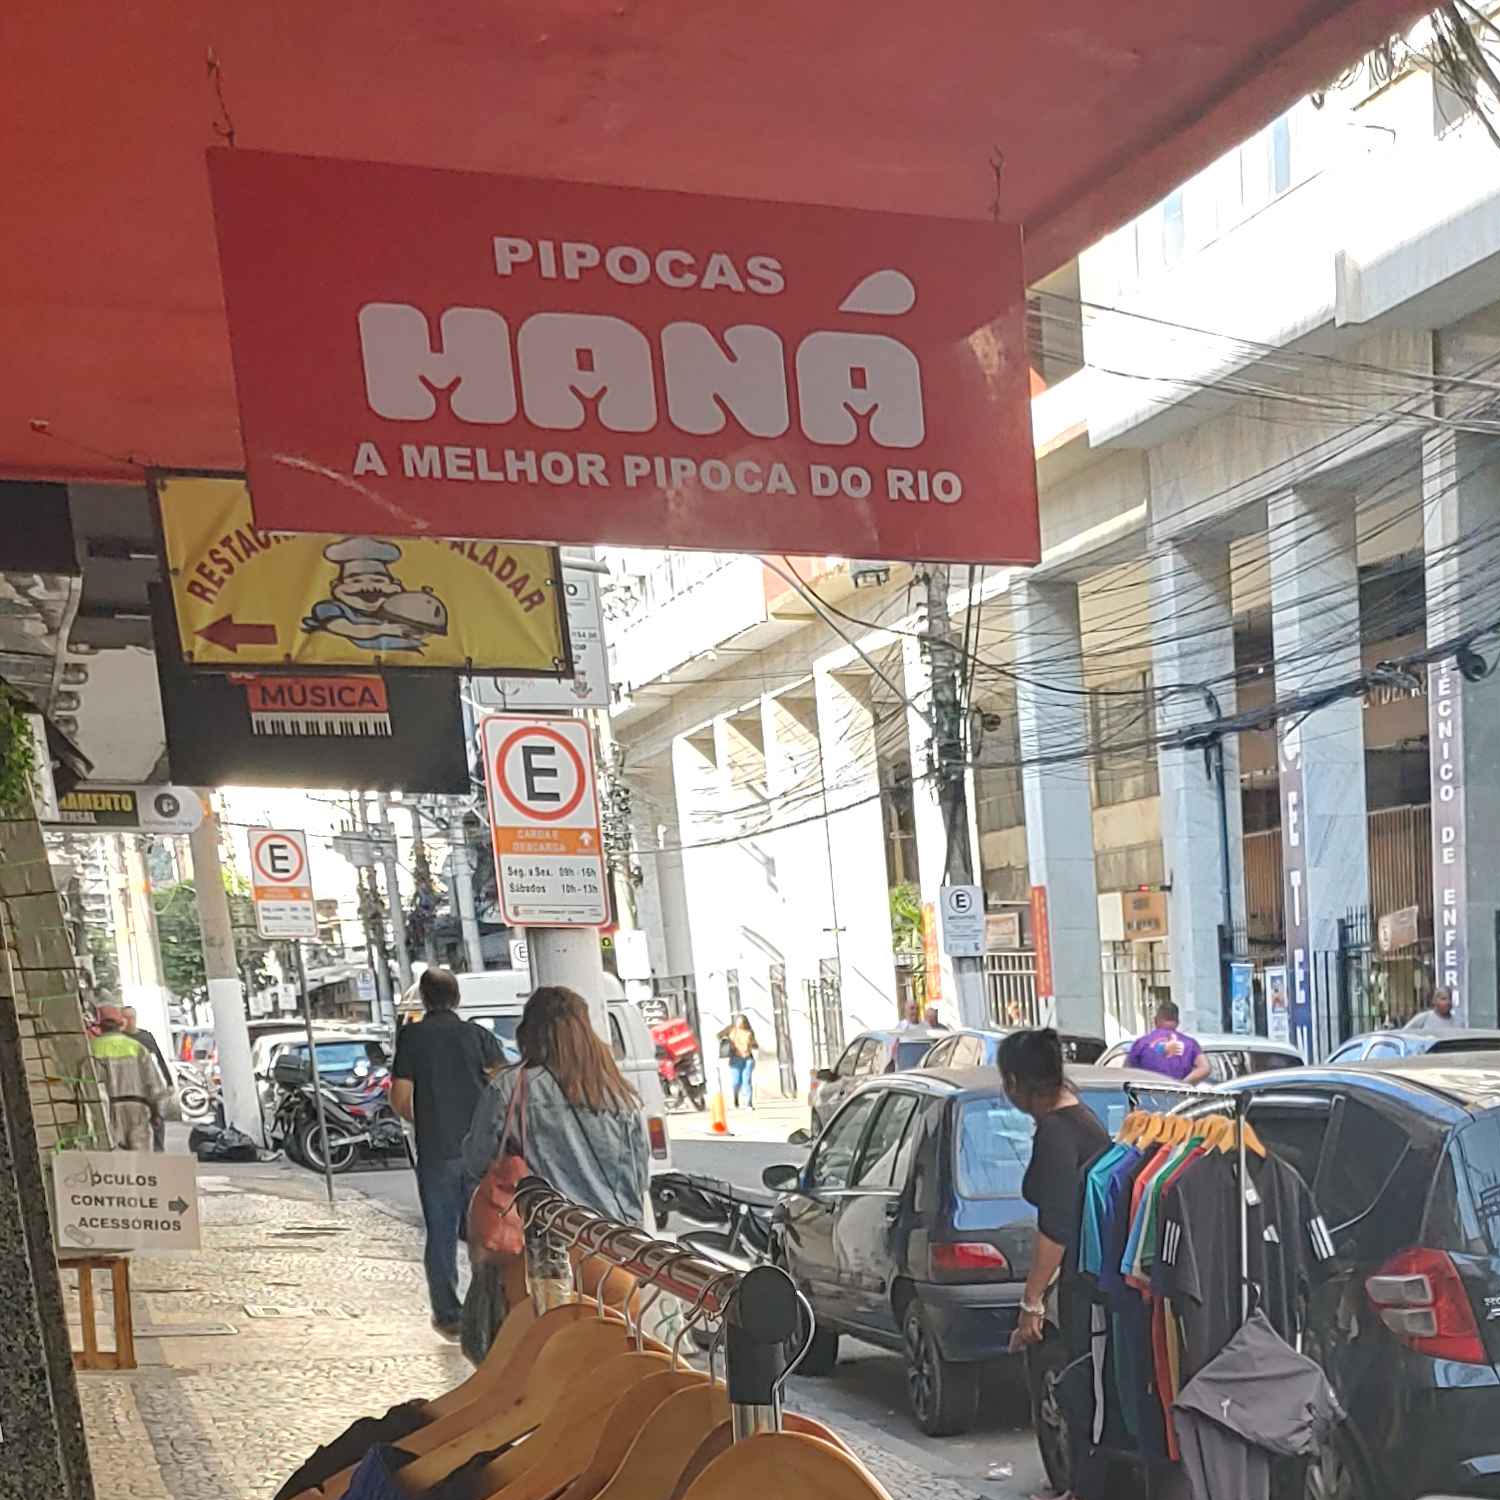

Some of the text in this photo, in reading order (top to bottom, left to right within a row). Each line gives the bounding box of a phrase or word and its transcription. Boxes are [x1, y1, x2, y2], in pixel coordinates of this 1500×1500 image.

[493, 235, 786, 296] PIPOCAS
[357, 269, 927, 449] MANÁ
[352, 441, 964, 504] A MELHOR PIPOCA DO RIO
[186, 521, 546, 613] RESTAU ALADAR
[260, 679, 379, 708] MÚSICA
[522, 745, 560, 802] E
[269, 844, 291, 873] E
[1442, 826, 1455, 865] DE
[955, 893, 968, 909] E
[71, 1195, 159, 1209] CONTROLE
[78, 1216, 182, 1232] ACESSÓRIOS
